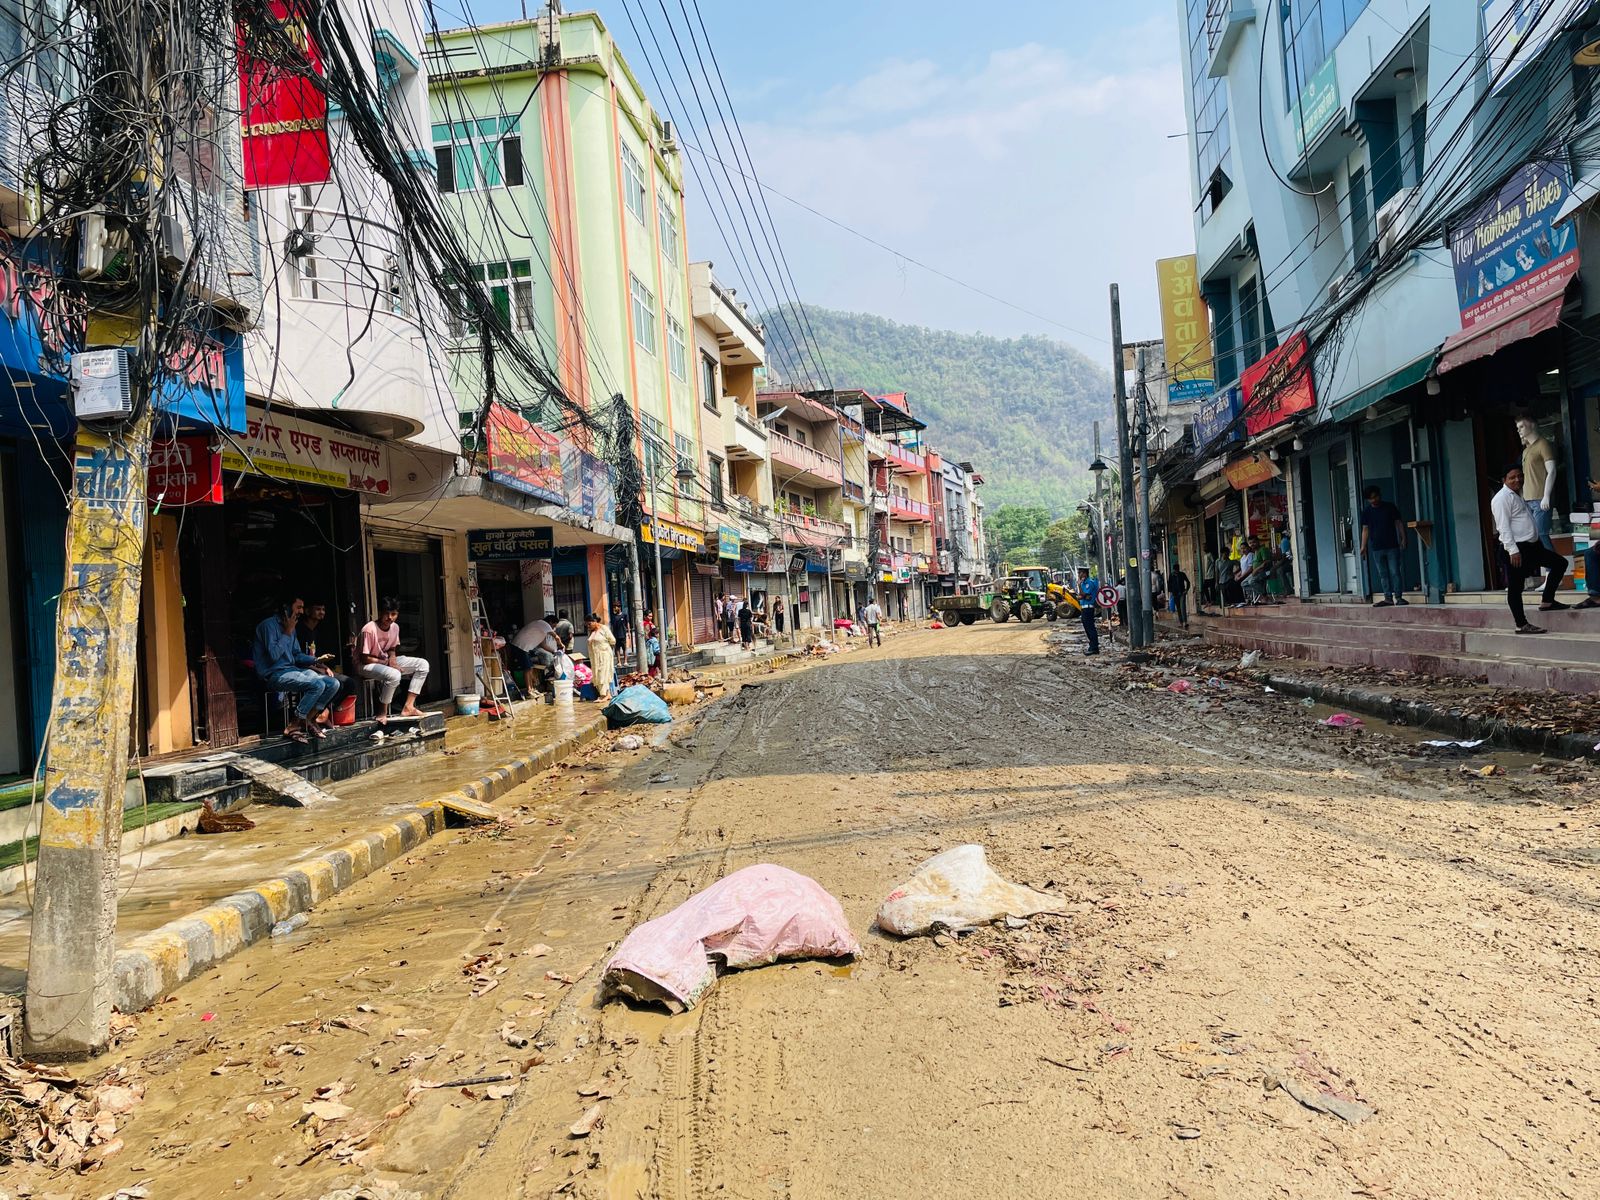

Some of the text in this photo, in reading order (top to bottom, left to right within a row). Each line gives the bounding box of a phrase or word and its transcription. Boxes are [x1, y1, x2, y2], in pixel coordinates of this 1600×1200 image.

[1524, 174, 1562, 218] Shoes
[288, 429, 322, 455] एण्ड
[329, 438, 381, 469] सप्लायर्स
[518, 539, 550, 550] पसल
